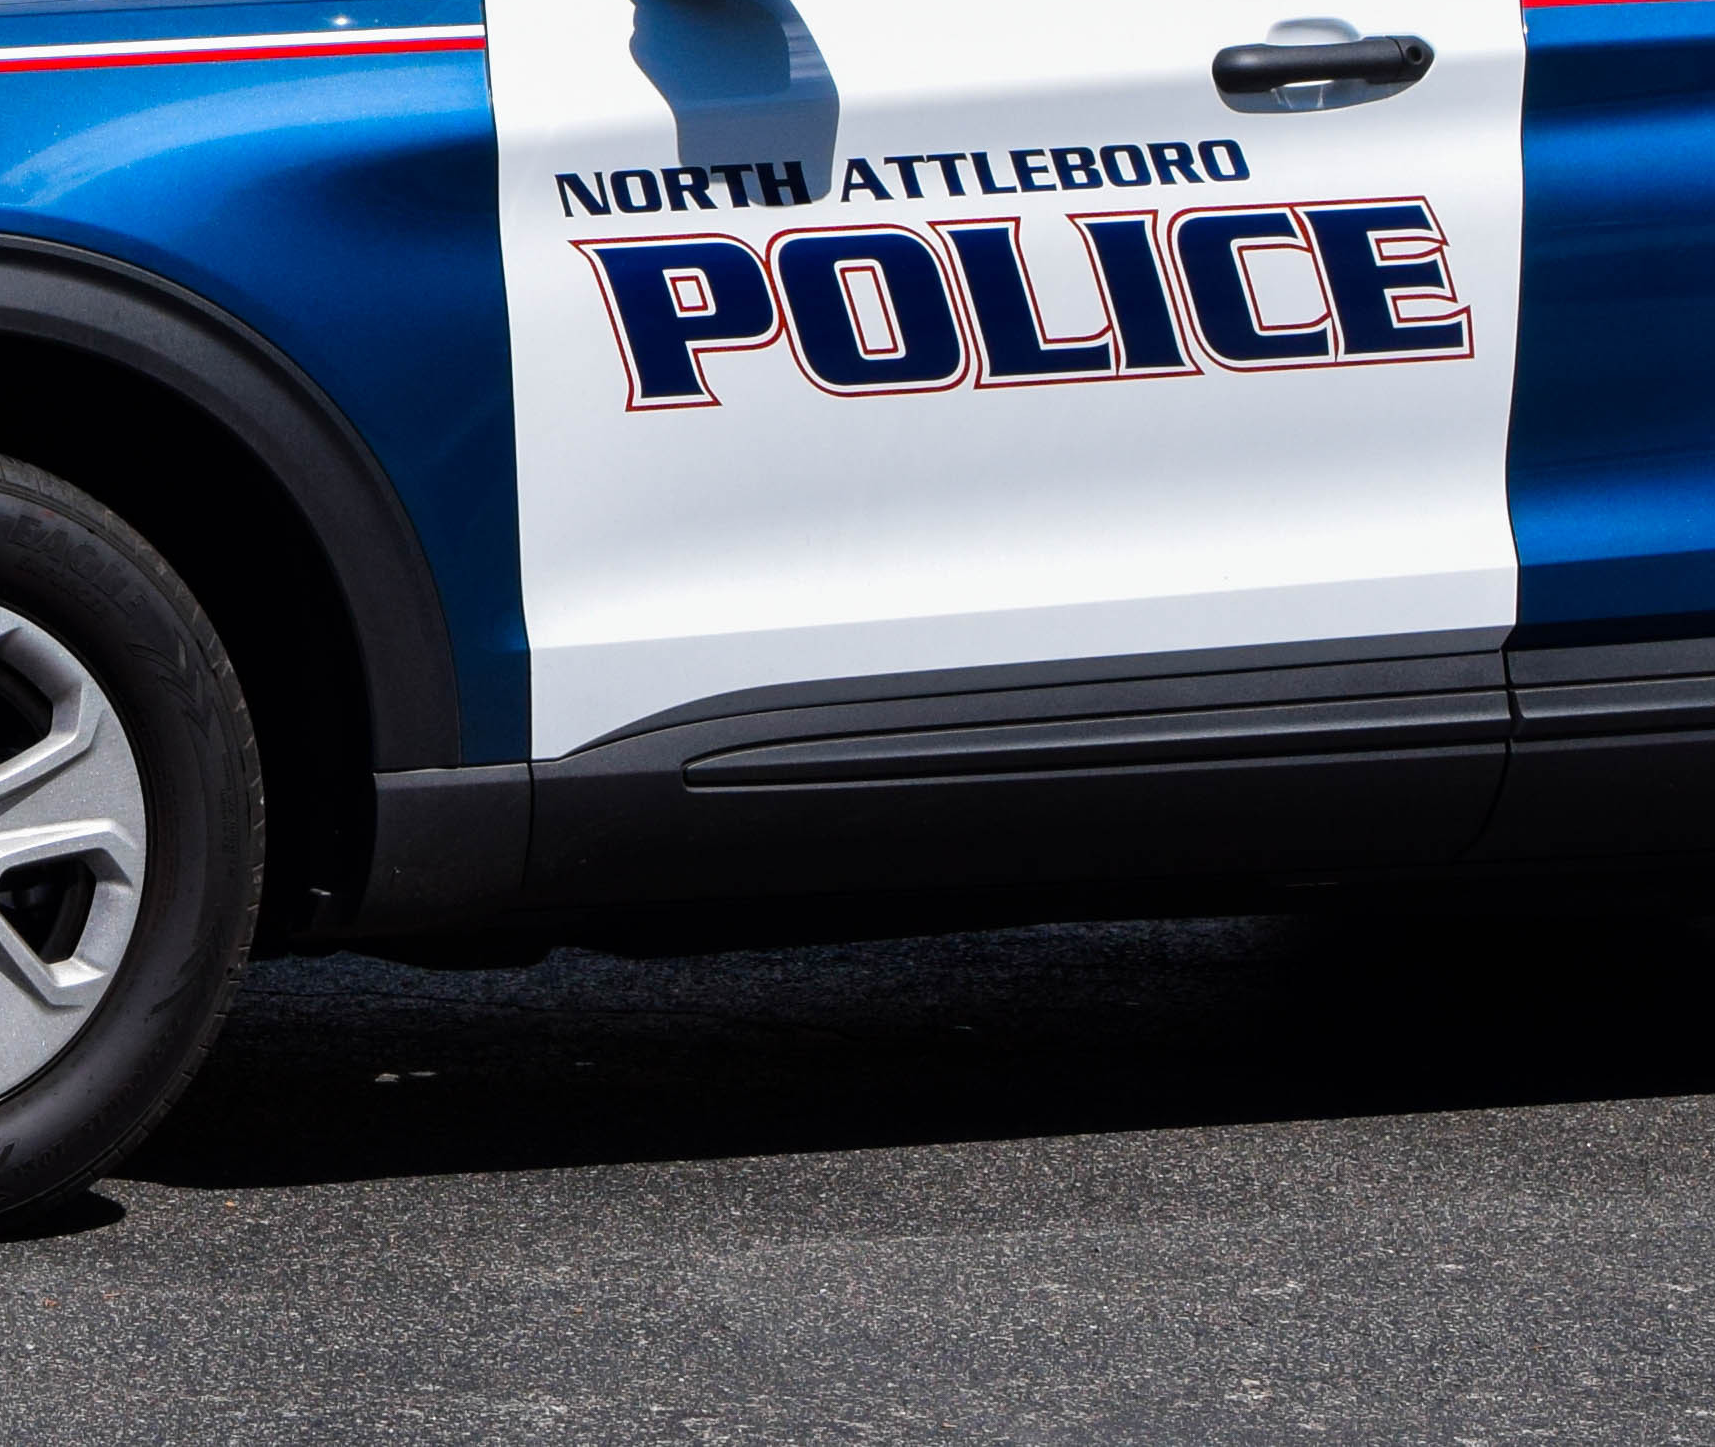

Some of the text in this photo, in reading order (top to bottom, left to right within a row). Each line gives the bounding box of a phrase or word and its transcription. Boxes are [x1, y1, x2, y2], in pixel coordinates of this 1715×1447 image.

[554, 139, 1251, 218] NORTH ATTLEBORO
[567, 195, 1476, 412] POLICE
